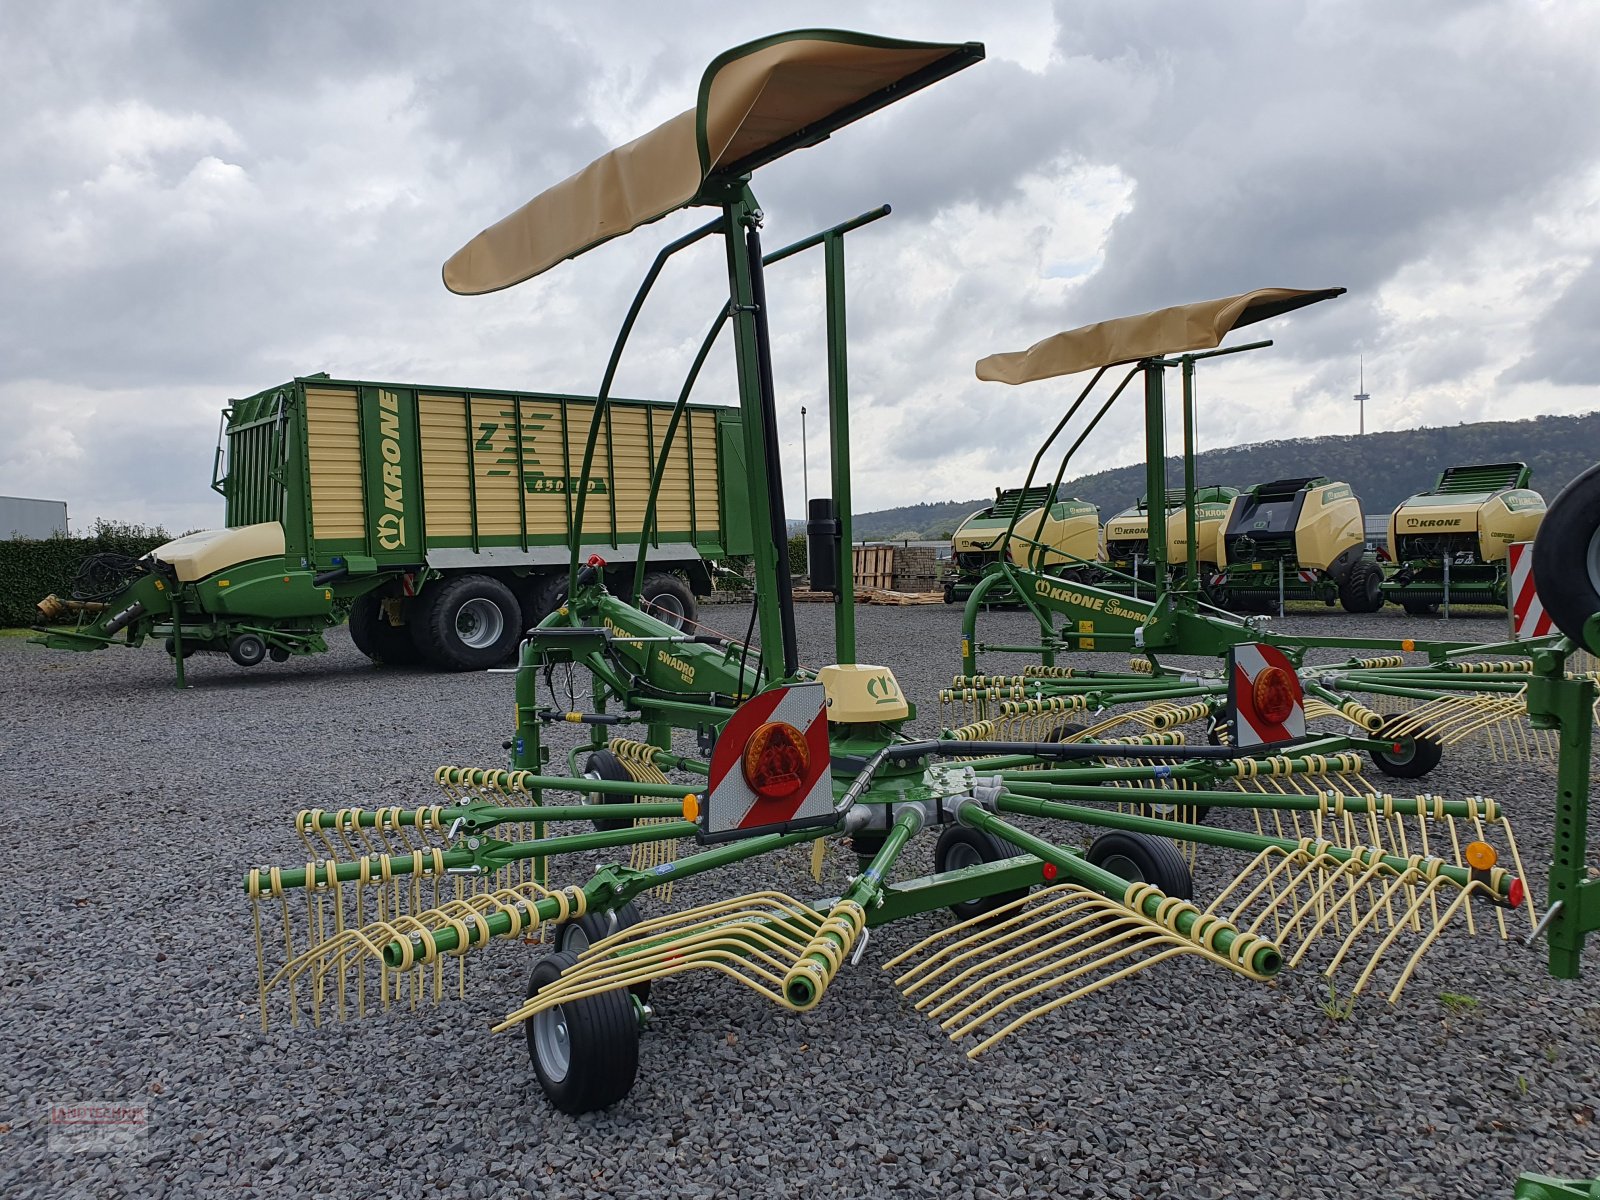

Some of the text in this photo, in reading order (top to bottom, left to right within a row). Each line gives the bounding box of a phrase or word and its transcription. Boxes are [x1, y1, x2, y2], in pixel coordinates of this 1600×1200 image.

[378, 388, 404, 512] KRONE
[534, 479, 564, 492] 450
[1205, 509, 1227, 517] KRON
[1420, 518, 1461, 528] KRONE
[1122, 527, 1149, 535] KRON
[1049, 587, 1105, 611] KRONE
[1104, 598, 1147, 623] SWADRO
[657, 650, 695, 677] SWADRO
